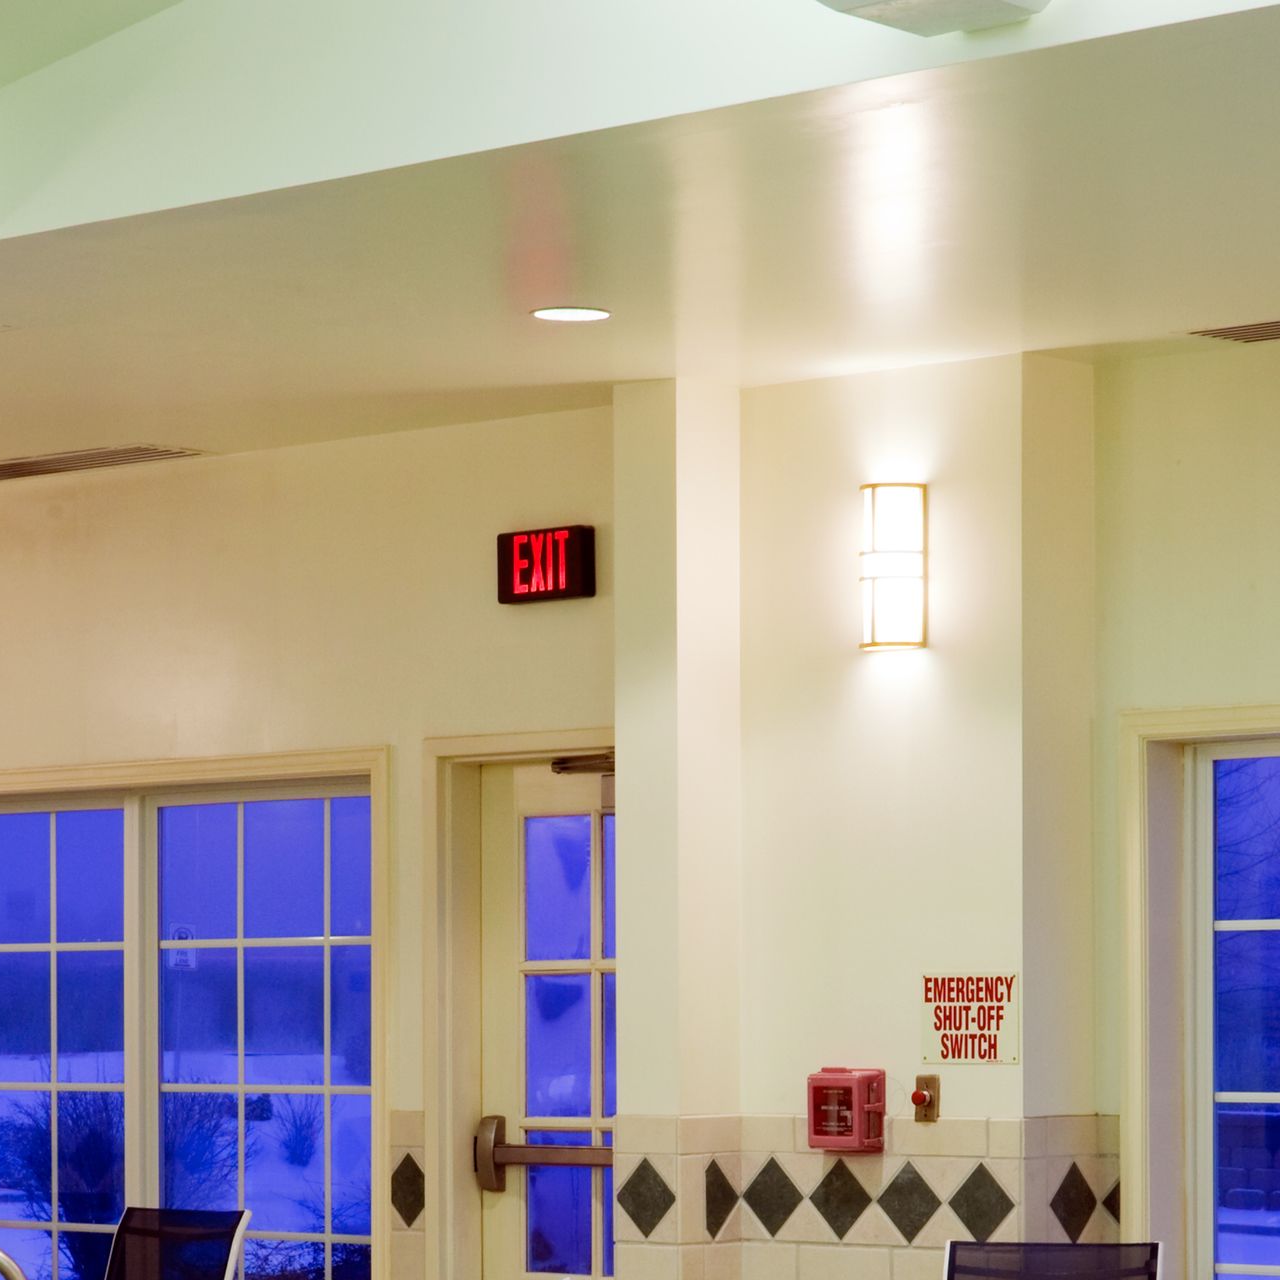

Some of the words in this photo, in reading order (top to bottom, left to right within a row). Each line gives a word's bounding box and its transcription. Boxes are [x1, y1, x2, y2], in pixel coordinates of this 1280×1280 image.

[512, 530, 569, 594] EXIT
[923, 976, 1014, 1003] EMERGENCY
[933, 1005, 1004, 1032] SHUT-OFF
[940, 1033, 998, 1060] SWITCH
